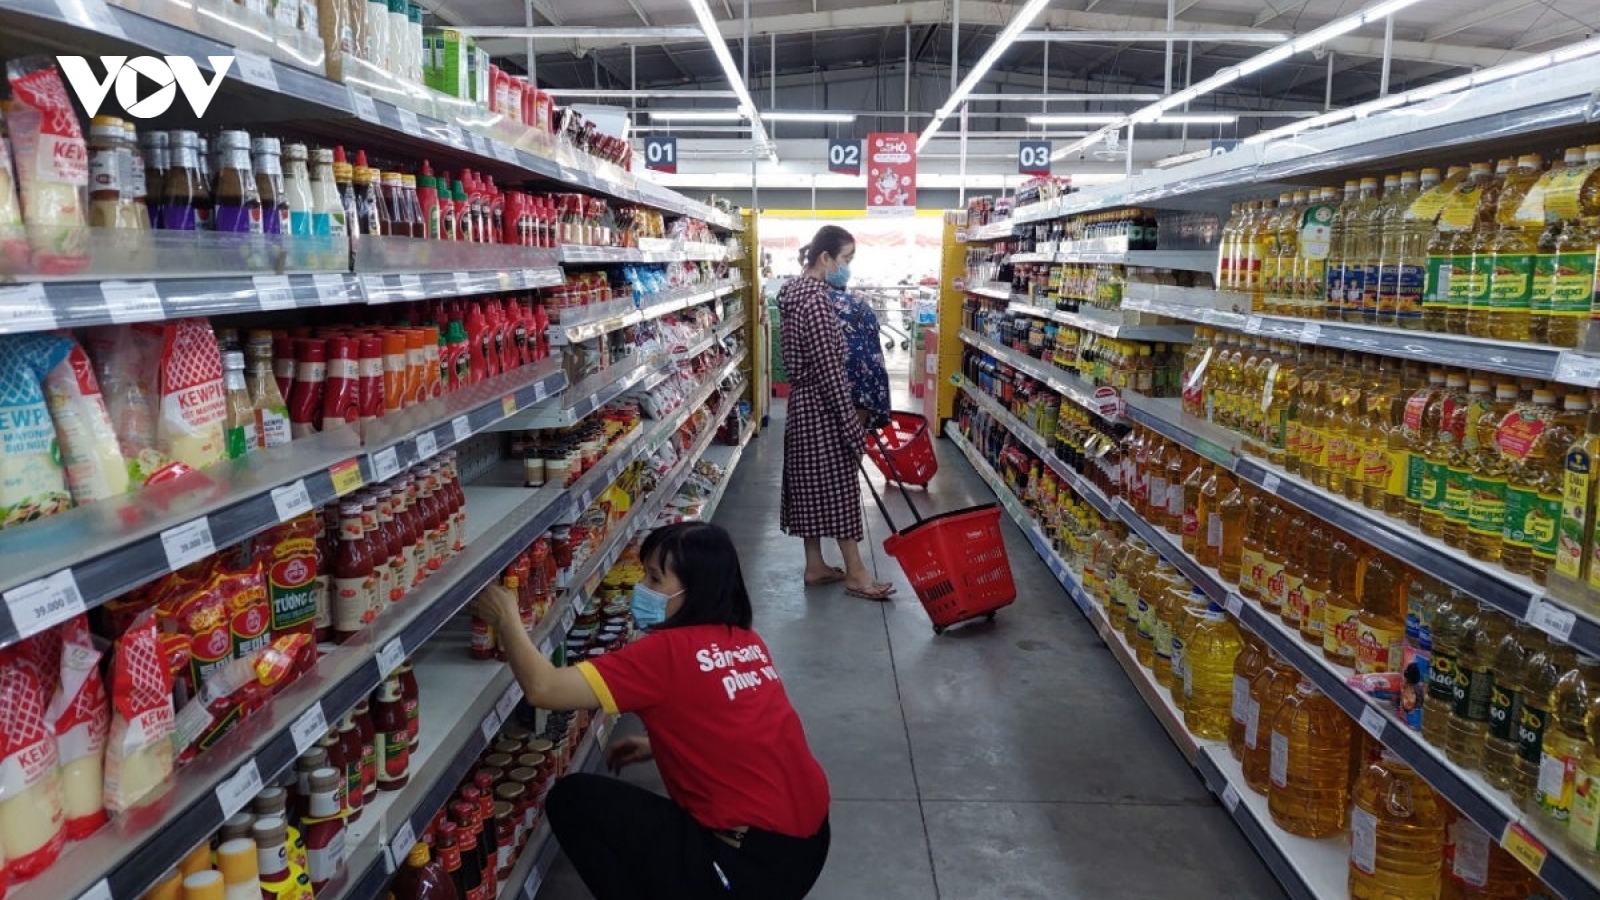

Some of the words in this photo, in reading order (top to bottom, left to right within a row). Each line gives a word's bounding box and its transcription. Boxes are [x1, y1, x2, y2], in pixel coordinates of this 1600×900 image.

[647, 142, 674, 162] 01
[830, 145, 860, 165] 02
[1020, 146, 1050, 166] 03
